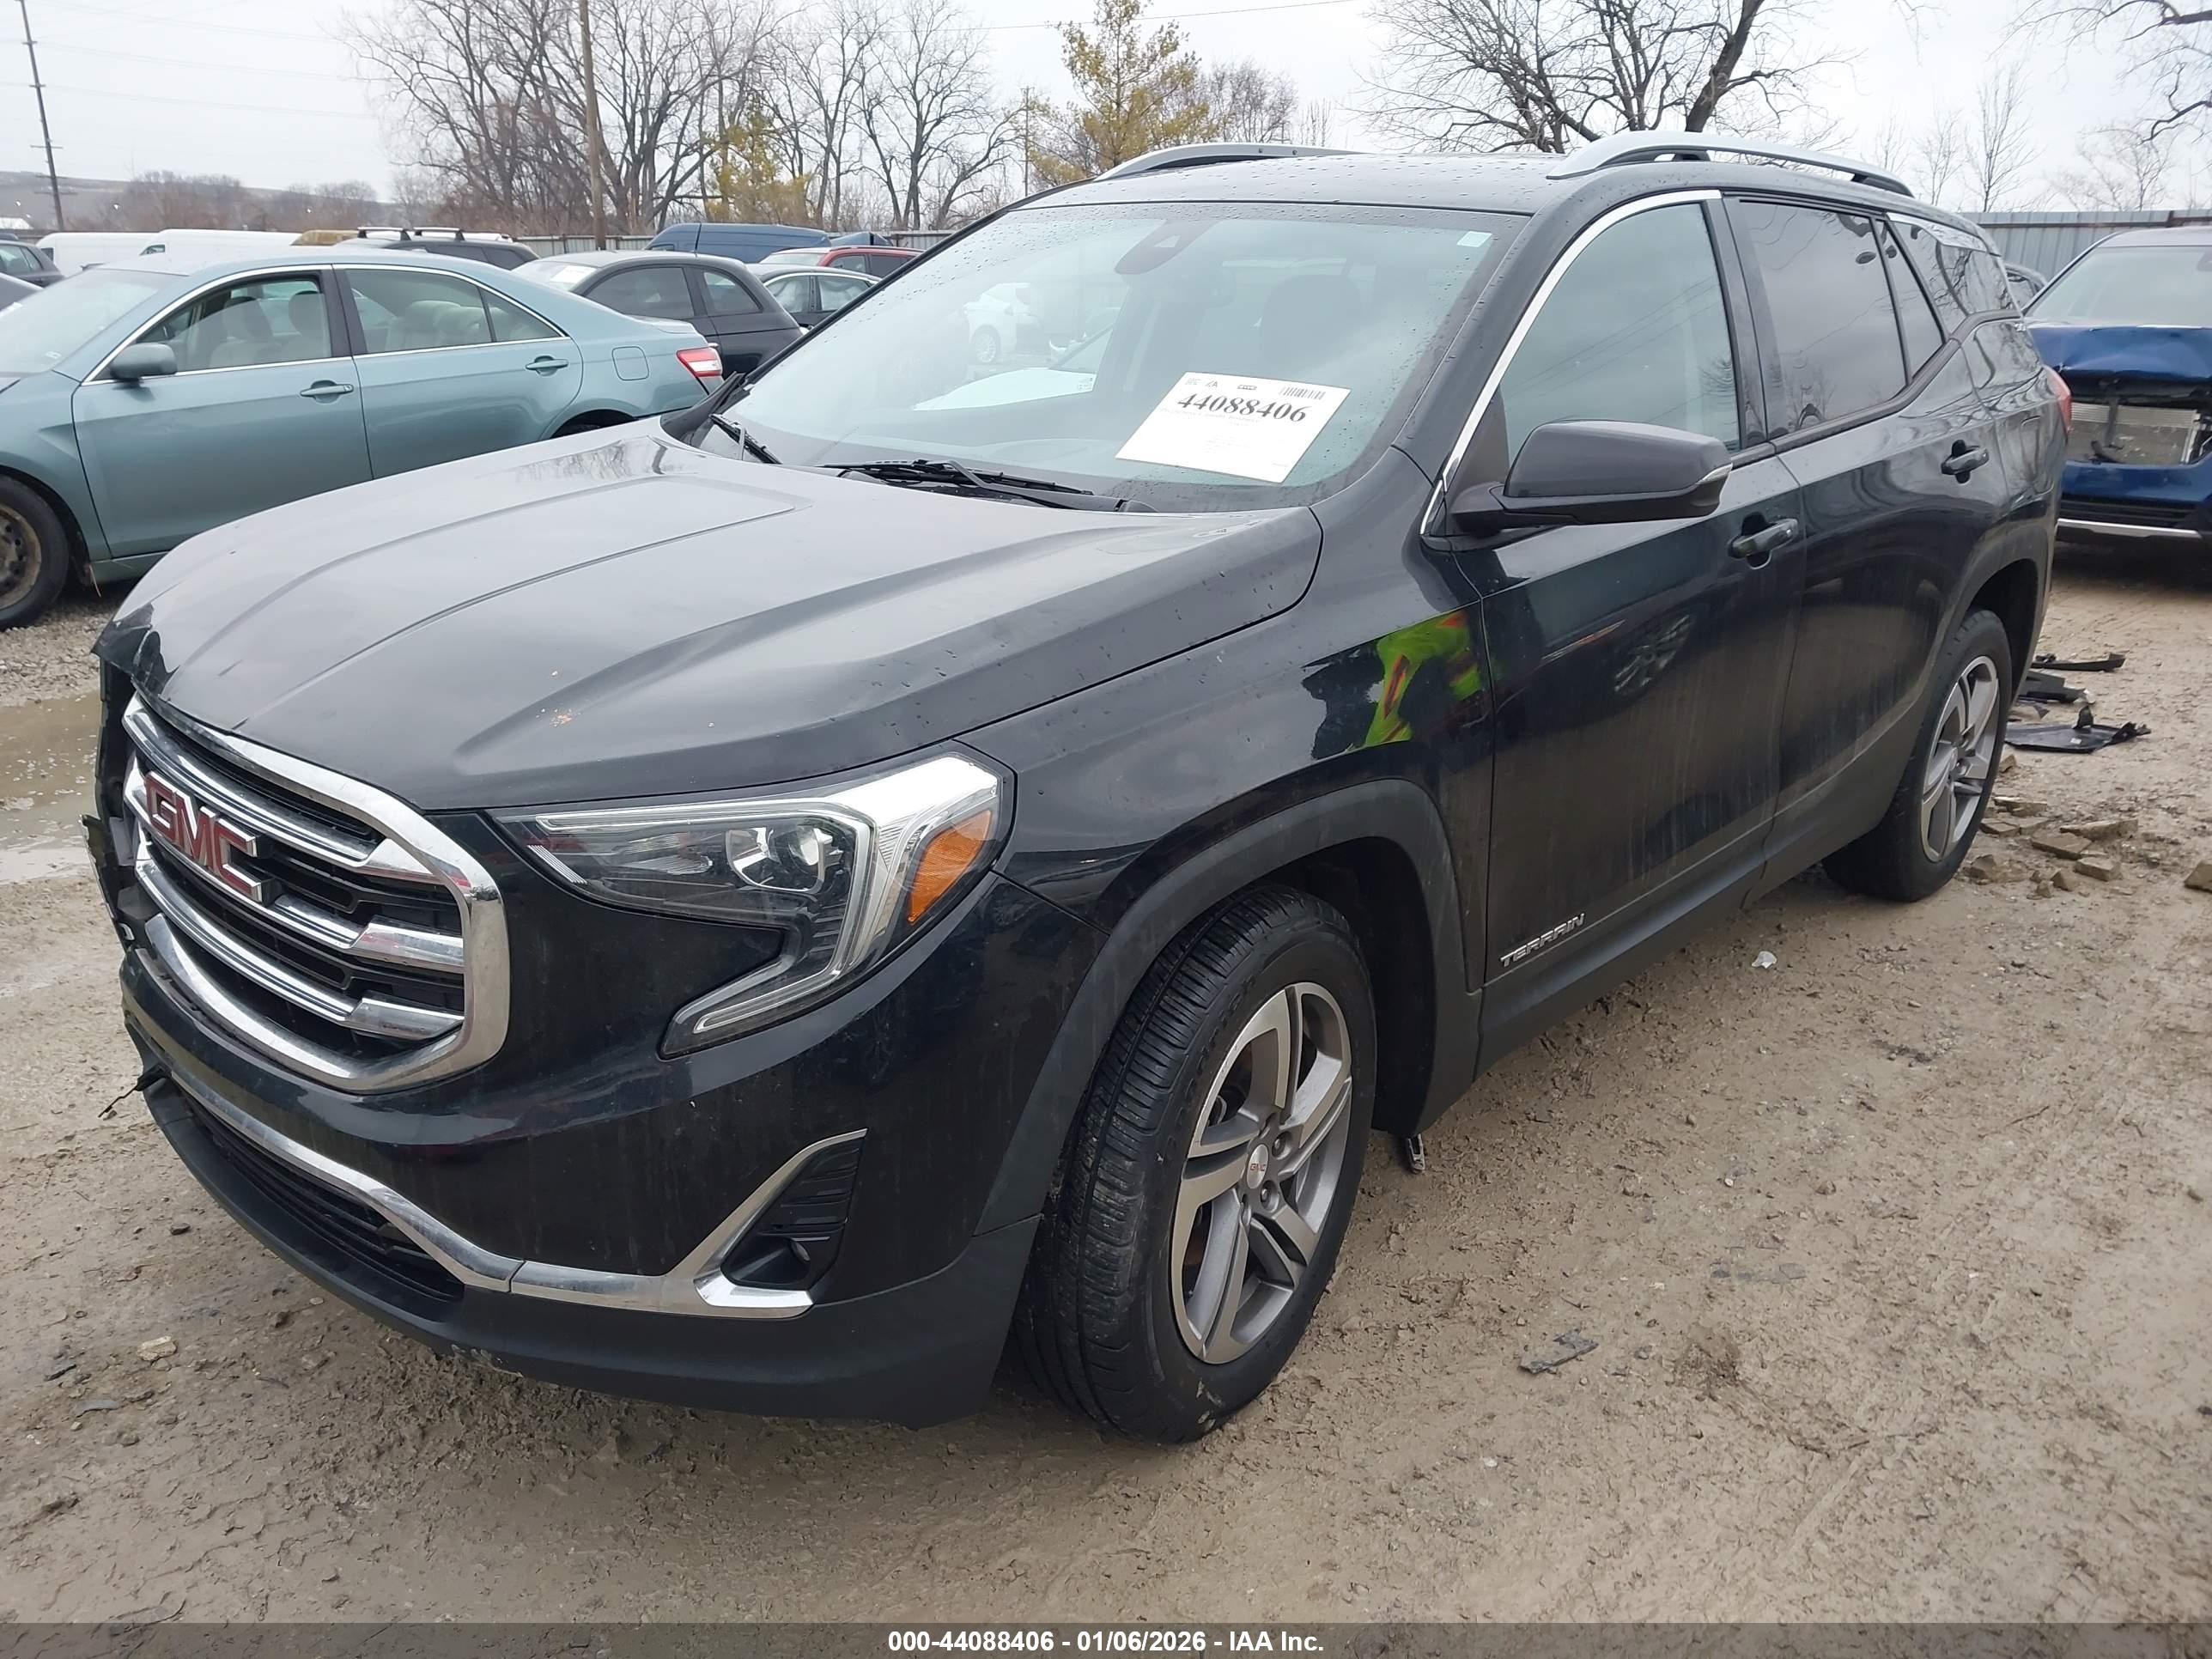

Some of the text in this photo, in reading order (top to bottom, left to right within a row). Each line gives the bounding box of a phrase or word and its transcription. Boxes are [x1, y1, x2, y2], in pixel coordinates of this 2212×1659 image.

[1177, 392, 1312, 422] 44088406
[144, 771, 263, 903] GMC
[1499, 913, 1585, 967] TERRAIN
